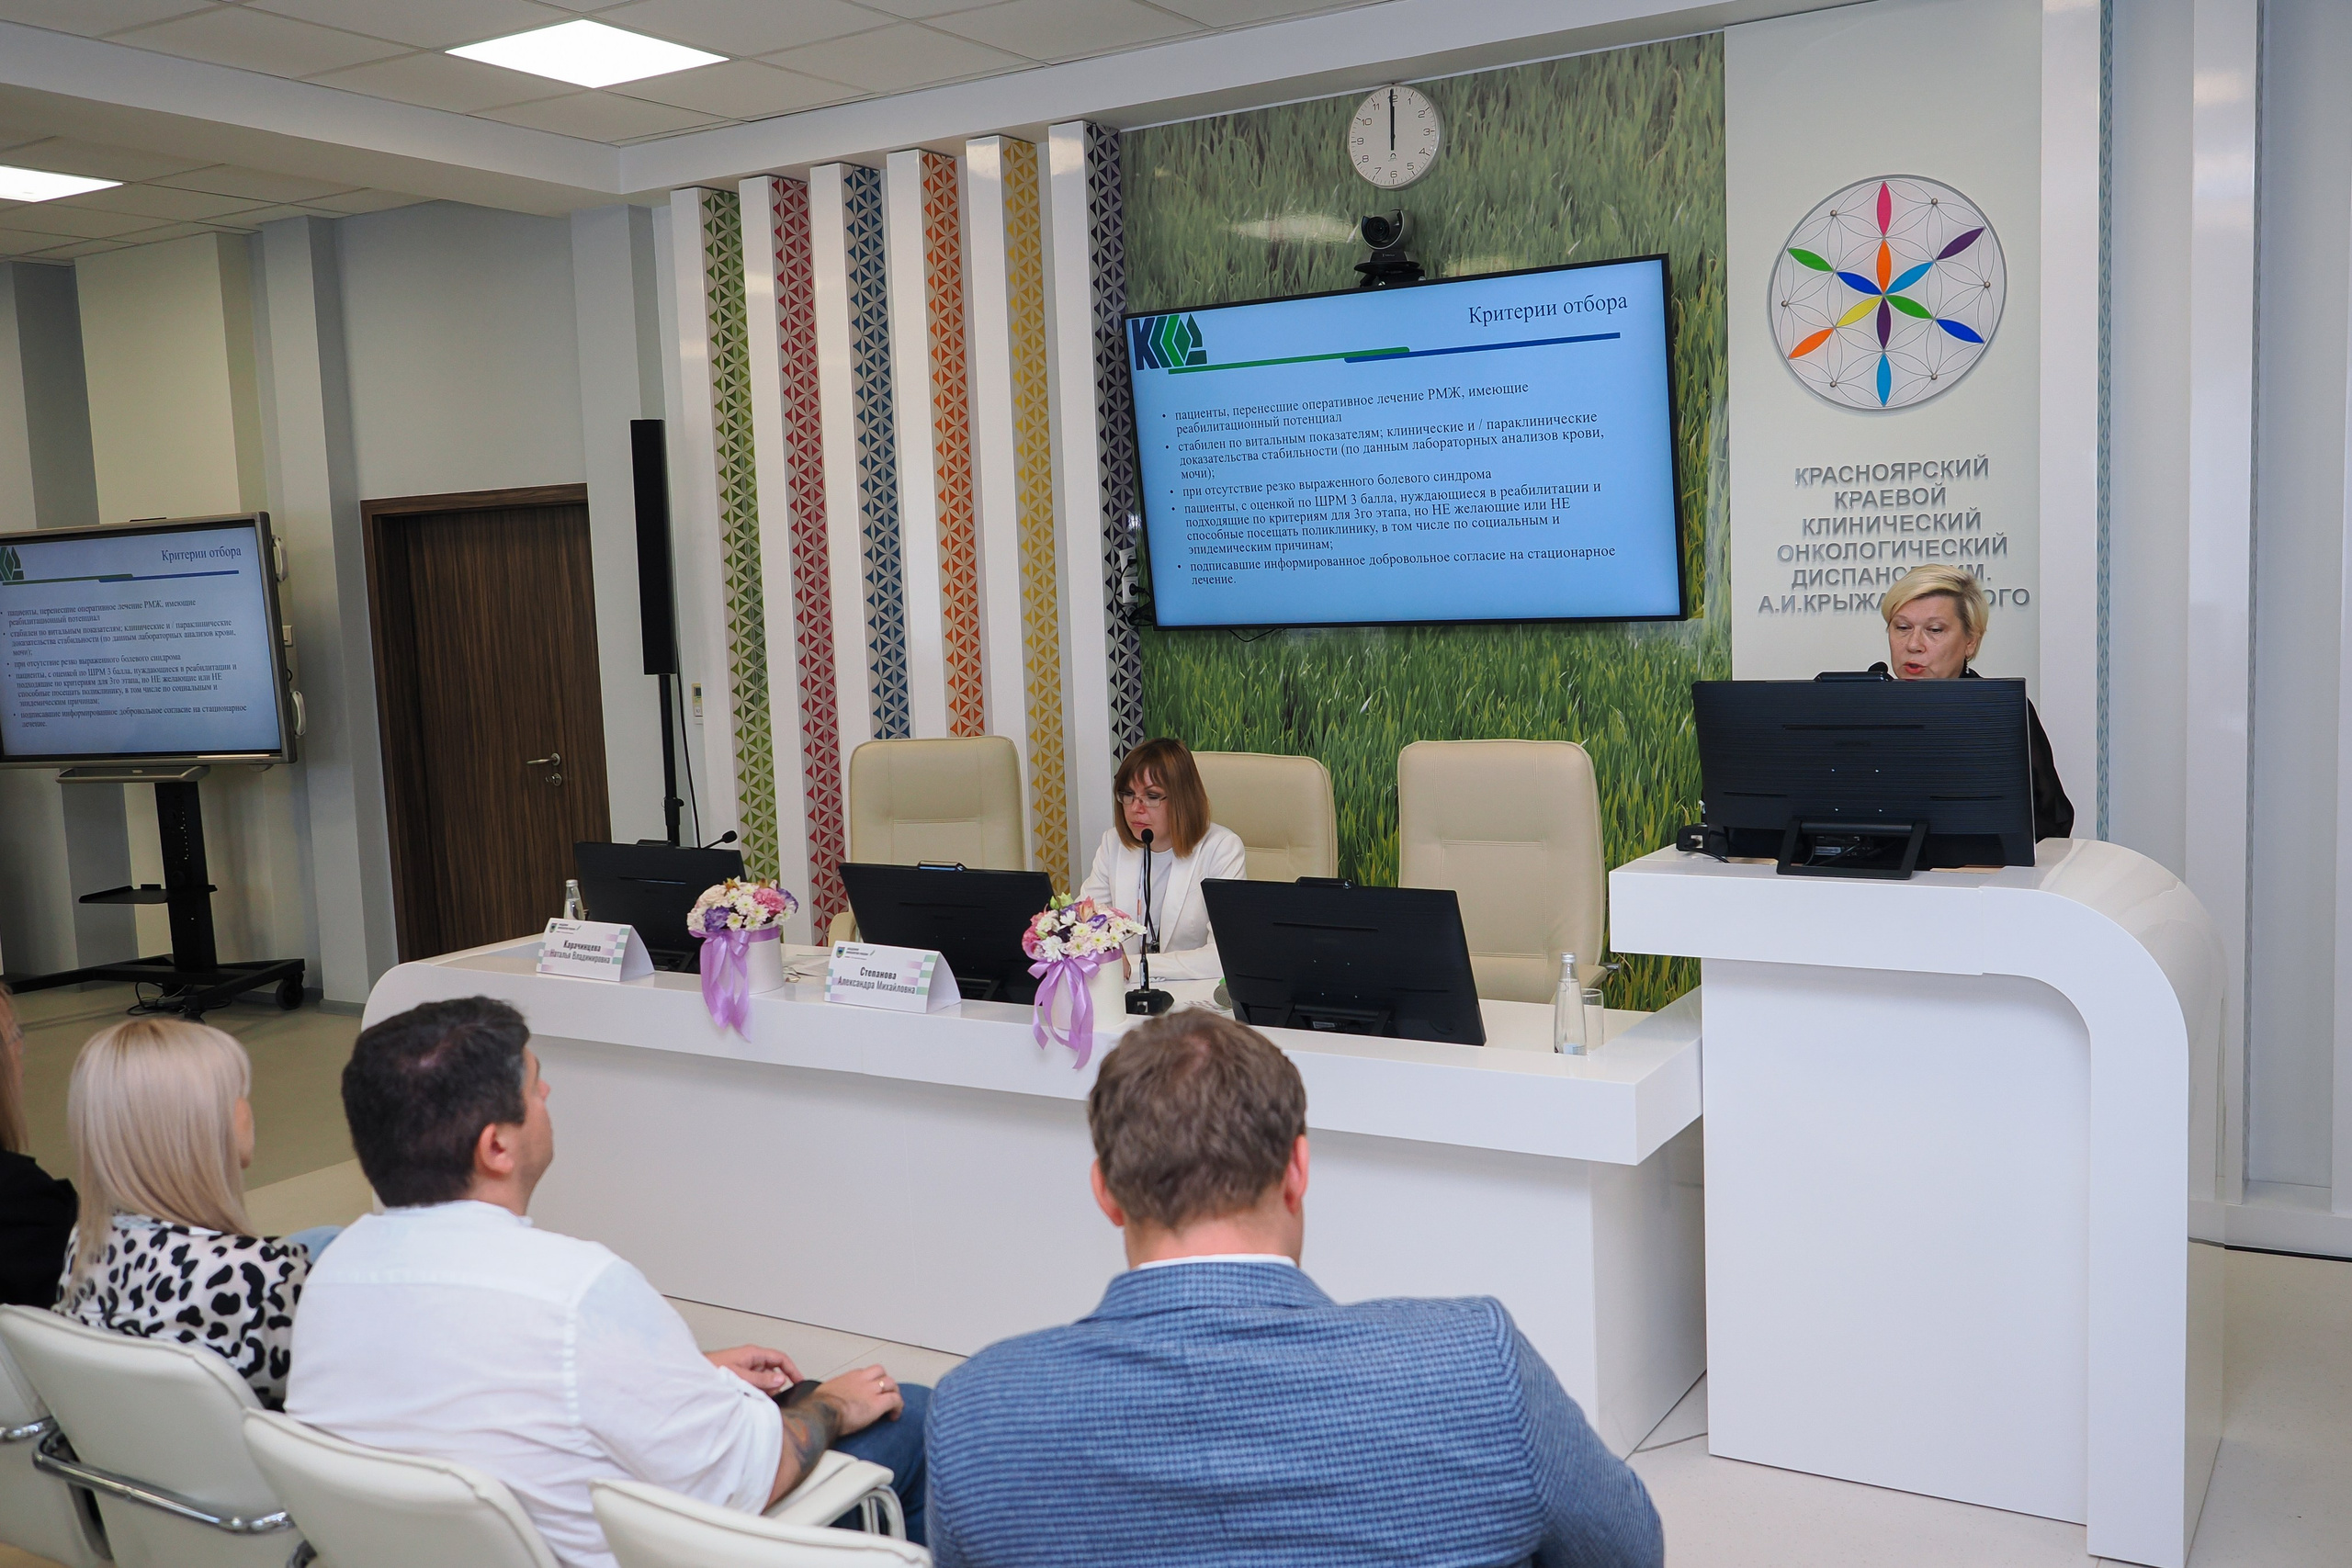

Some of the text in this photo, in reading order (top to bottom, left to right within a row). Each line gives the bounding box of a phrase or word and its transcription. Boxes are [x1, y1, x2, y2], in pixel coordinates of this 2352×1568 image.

[1373, 103, 1380, 111] 11
[1387, 95, 1398, 103] 2
[1408, 97, 1411, 106] 1
[1362, 118, 1373, 126] 10
[1418, 110, 1426, 118] 2
[1422, 128, 1430, 136] 3
[1357, 137, 1364, 145] 9
[1362, 154, 1370, 163] 8
[1407, 163, 1415, 171] 5
[1374, 166, 1382, 175] 7
[1390, 170, 1398, 178] 6
[1468, 293, 1628, 327] Критерии отбора
[1175, 384, 1529, 420] пациенты, перенесшие оперативное лечение РМЖ, имеющие
[1176, 413, 1341, 437] реабилитационный потенциал
[1178, 413, 1597, 451] стабилен по витальным показателям; клинические и / параклинические
[1179, 428, 1603, 466] доказательства стабильности (по данным лабораторных анализов крови,
[1181, 467, 1215, 480] мочи);
[1794, 453, 1989, 485] КРАСНОЯРСКИЙ
[1182, 470, 1492, 499] при отсутствие резко выраженного болевого синдрома
[1184, 503, 1238, 513] пациенты,
[1250, 497, 1295, 511] оценкой
[1297, 499, 1311, 507] по
[1314, 494, 1347, 506] ШРМ
[1351, 493, 1356, 504] 3
[1360, 492, 1396, 504] балла,
[1400, 489, 1486, 504] нуждающиеся
[1489, 489, 1497, 497] в
[1499, 483, 1589, 500] реабилитации
[1593, 483, 1600, 491] и
[1834, 482, 1946, 509] КРАЕВОЙ
[1185, 496, 1570, 527] подходящие по критериям для 3го этапа, но НЕ желающие или НЕ
[1187, 515, 1560, 540] способные посещать поликлинику, в том числе по социальным и
[1802, 507, 1982, 536] КЛИНИЧЕСКИЙ
[161, 546, 242, 563] Критерии отбора
[1188, 540, 1333, 555] эпидемическим причинам;
[1777, 532, 2007, 561] ОНКОЛОГИЧЕСКИЙ
[1190, 547, 1615, 572] подписавшие информированное добровольное согласие на стационарное
[1192, 576, 1236, 584] лечение.
[1792, 566, 1918, 590] ДИСПАНС
[571, 952, 610, 964] Владимировна
[860, 966, 897, 980] Степанова
[837, 976, 916, 994] Александра Михайловна
